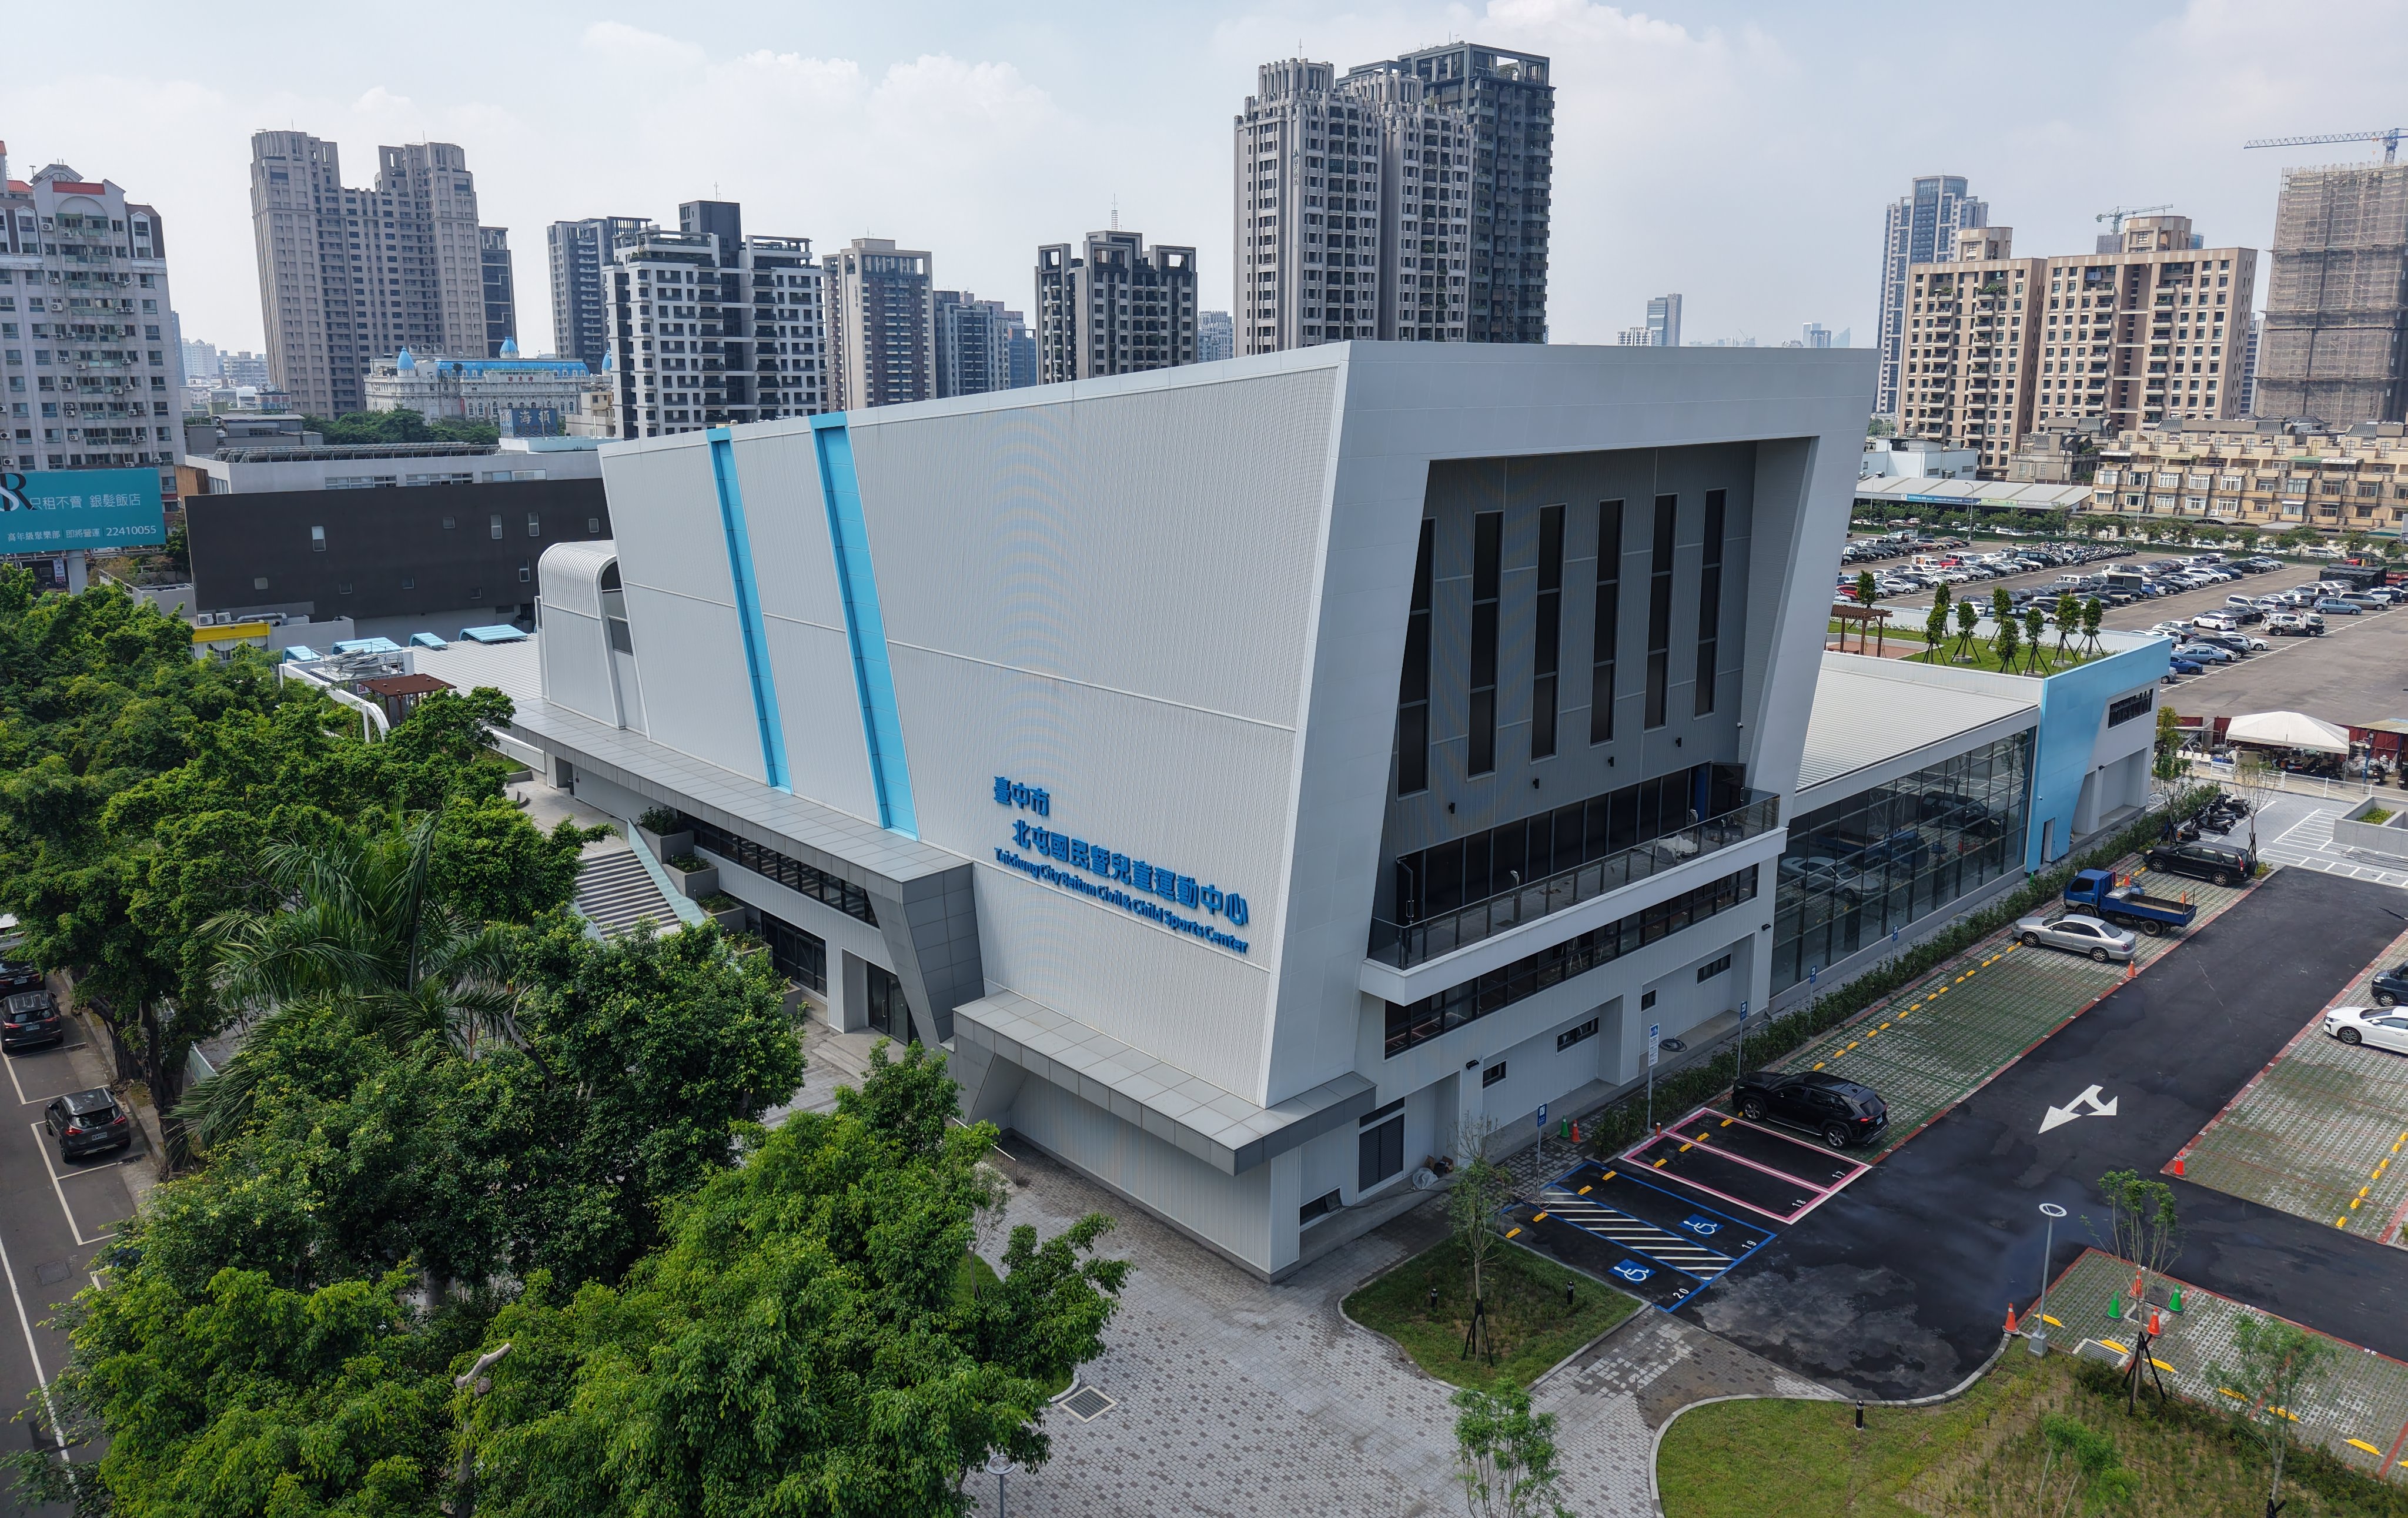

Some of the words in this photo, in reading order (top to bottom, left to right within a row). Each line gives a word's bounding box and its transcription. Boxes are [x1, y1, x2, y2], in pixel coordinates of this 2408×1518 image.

[29, 496, 82, 510] 只租不賣
[89, 493, 141, 508] 銀髮飯店
[66, 528, 101, 539] 即將營運
[106, 525, 156, 536] 22410055
[994, 776, 1050, 815] 臺中市
[1012, 819, 1249, 925] 北屯國民暨兒童運動中心
[994, 847, 1039, 878] Taichung
[1039, 864, 1061, 885] City
[1062, 872, 1096, 898] Beitun
[1096, 885, 1122, 906] Civil
[1122, 894, 1132, 910] &
[1132, 899, 1163, 922] Child
[1163, 910, 1204, 937] Sports
[1205, 925, 1249, 953] Center
[1832, 1171, 1846, 1179] 17
[1792, 1199, 1807, 1208] 18
[1741, 1240, 1757, 1250] 19
[1673, 1288, 1690, 1299] 20
